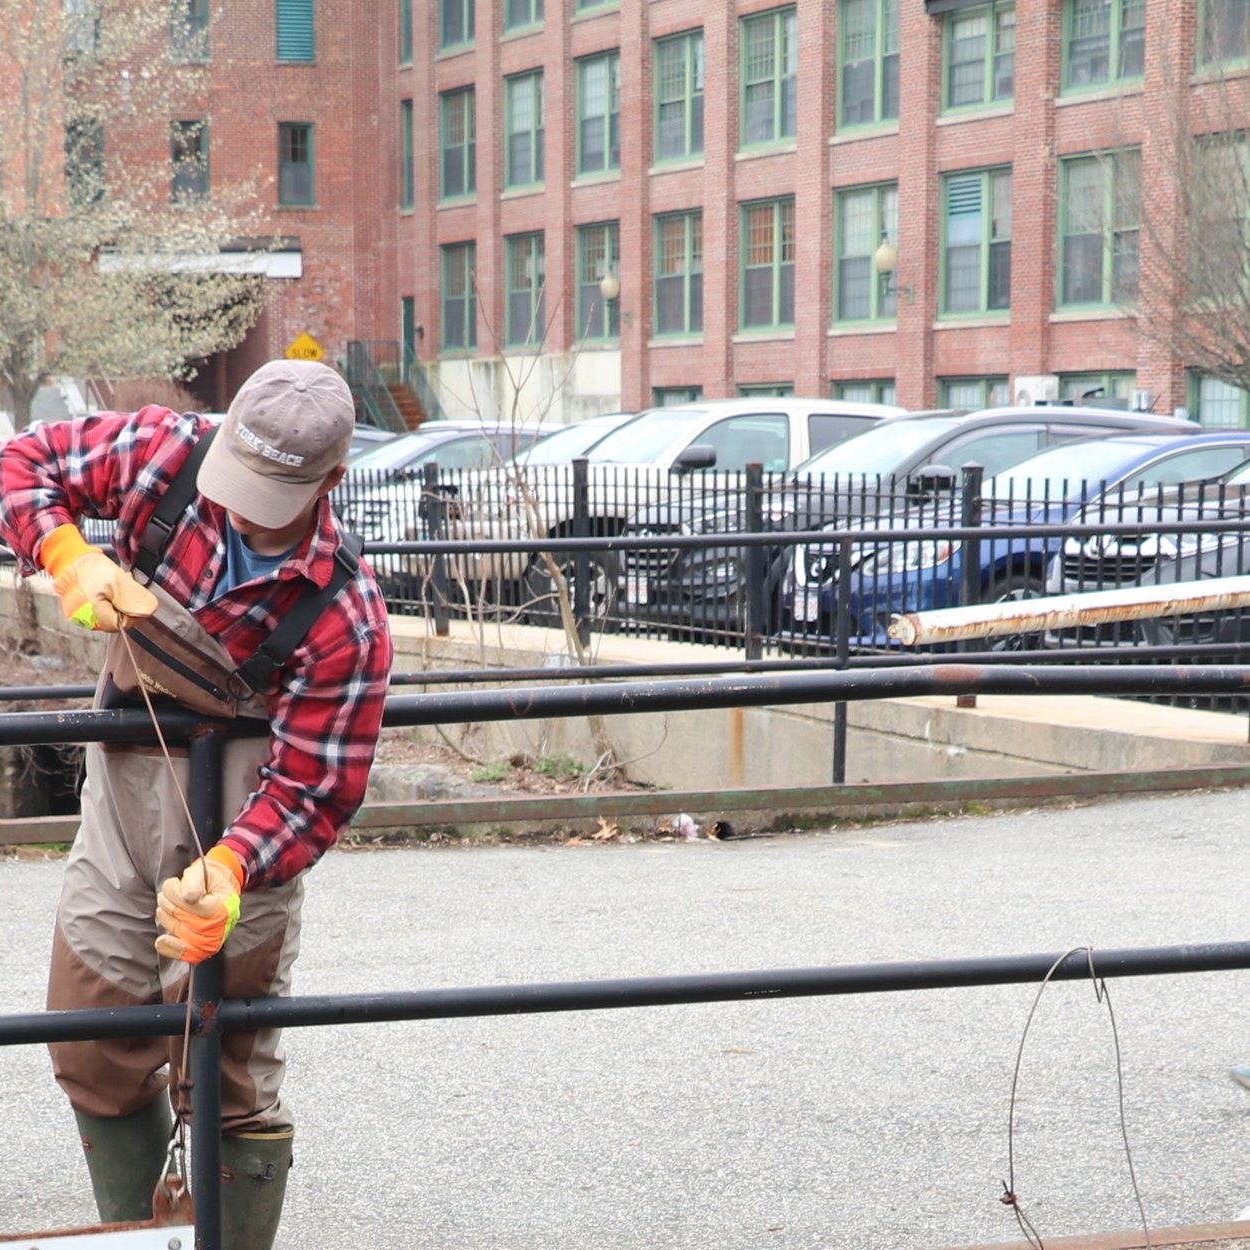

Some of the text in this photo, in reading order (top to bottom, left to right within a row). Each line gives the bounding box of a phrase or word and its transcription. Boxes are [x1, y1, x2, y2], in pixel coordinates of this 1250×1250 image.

[291, 348, 318, 358] SLOW
[235, 422, 305, 467] YORK BEACH
